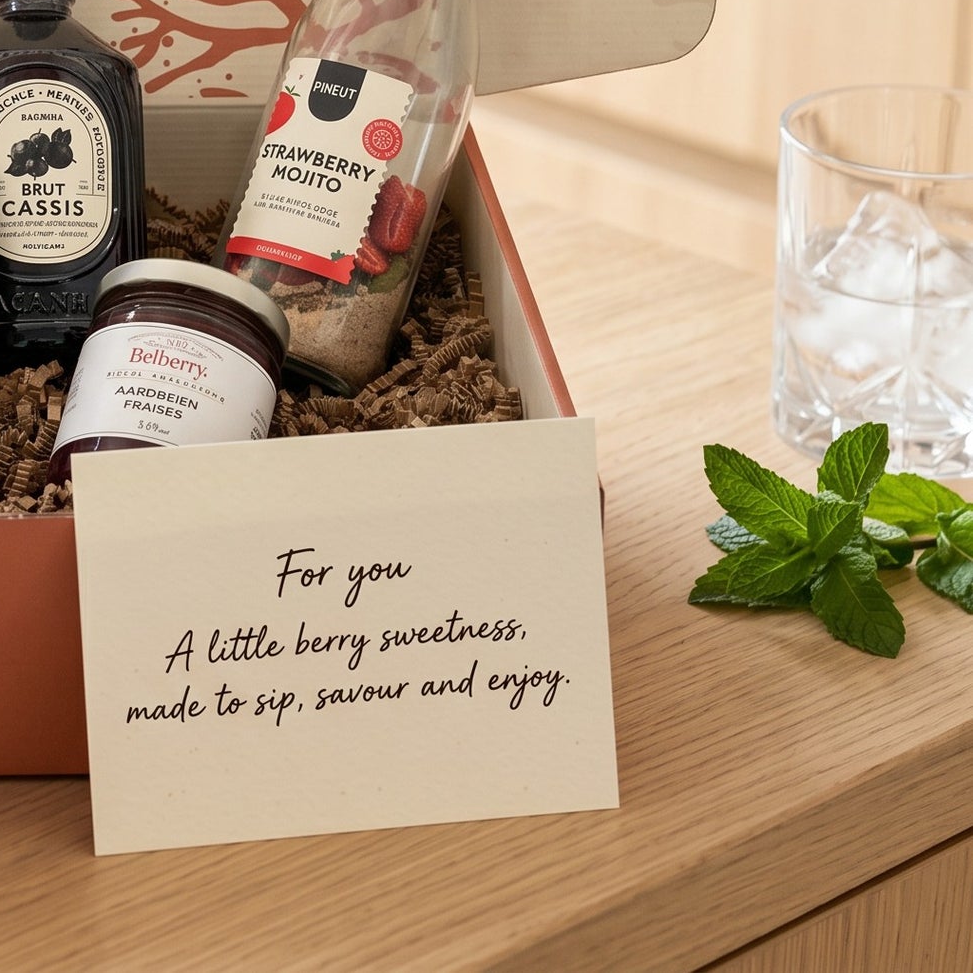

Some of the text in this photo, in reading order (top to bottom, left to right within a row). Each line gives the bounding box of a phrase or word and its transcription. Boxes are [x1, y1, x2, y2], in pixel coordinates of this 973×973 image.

[313, 80, 358, 101] PINEUT
[261, 142, 377, 182] STRAWBERRY
[22, 183, 65, 196] BRUT
[271, 164, 342, 193] MOJITO
[1, 200, 84, 216] CASSIS
[114, 385, 199, 410] AARDBEIEN
[123, 399, 183, 419] FRAISES
[276, 547, 412, 608] For you
[165, 610, 527, 674] A little berry sweetness,
[126, 660, 571, 727] made to sip, savour and enjoy.
